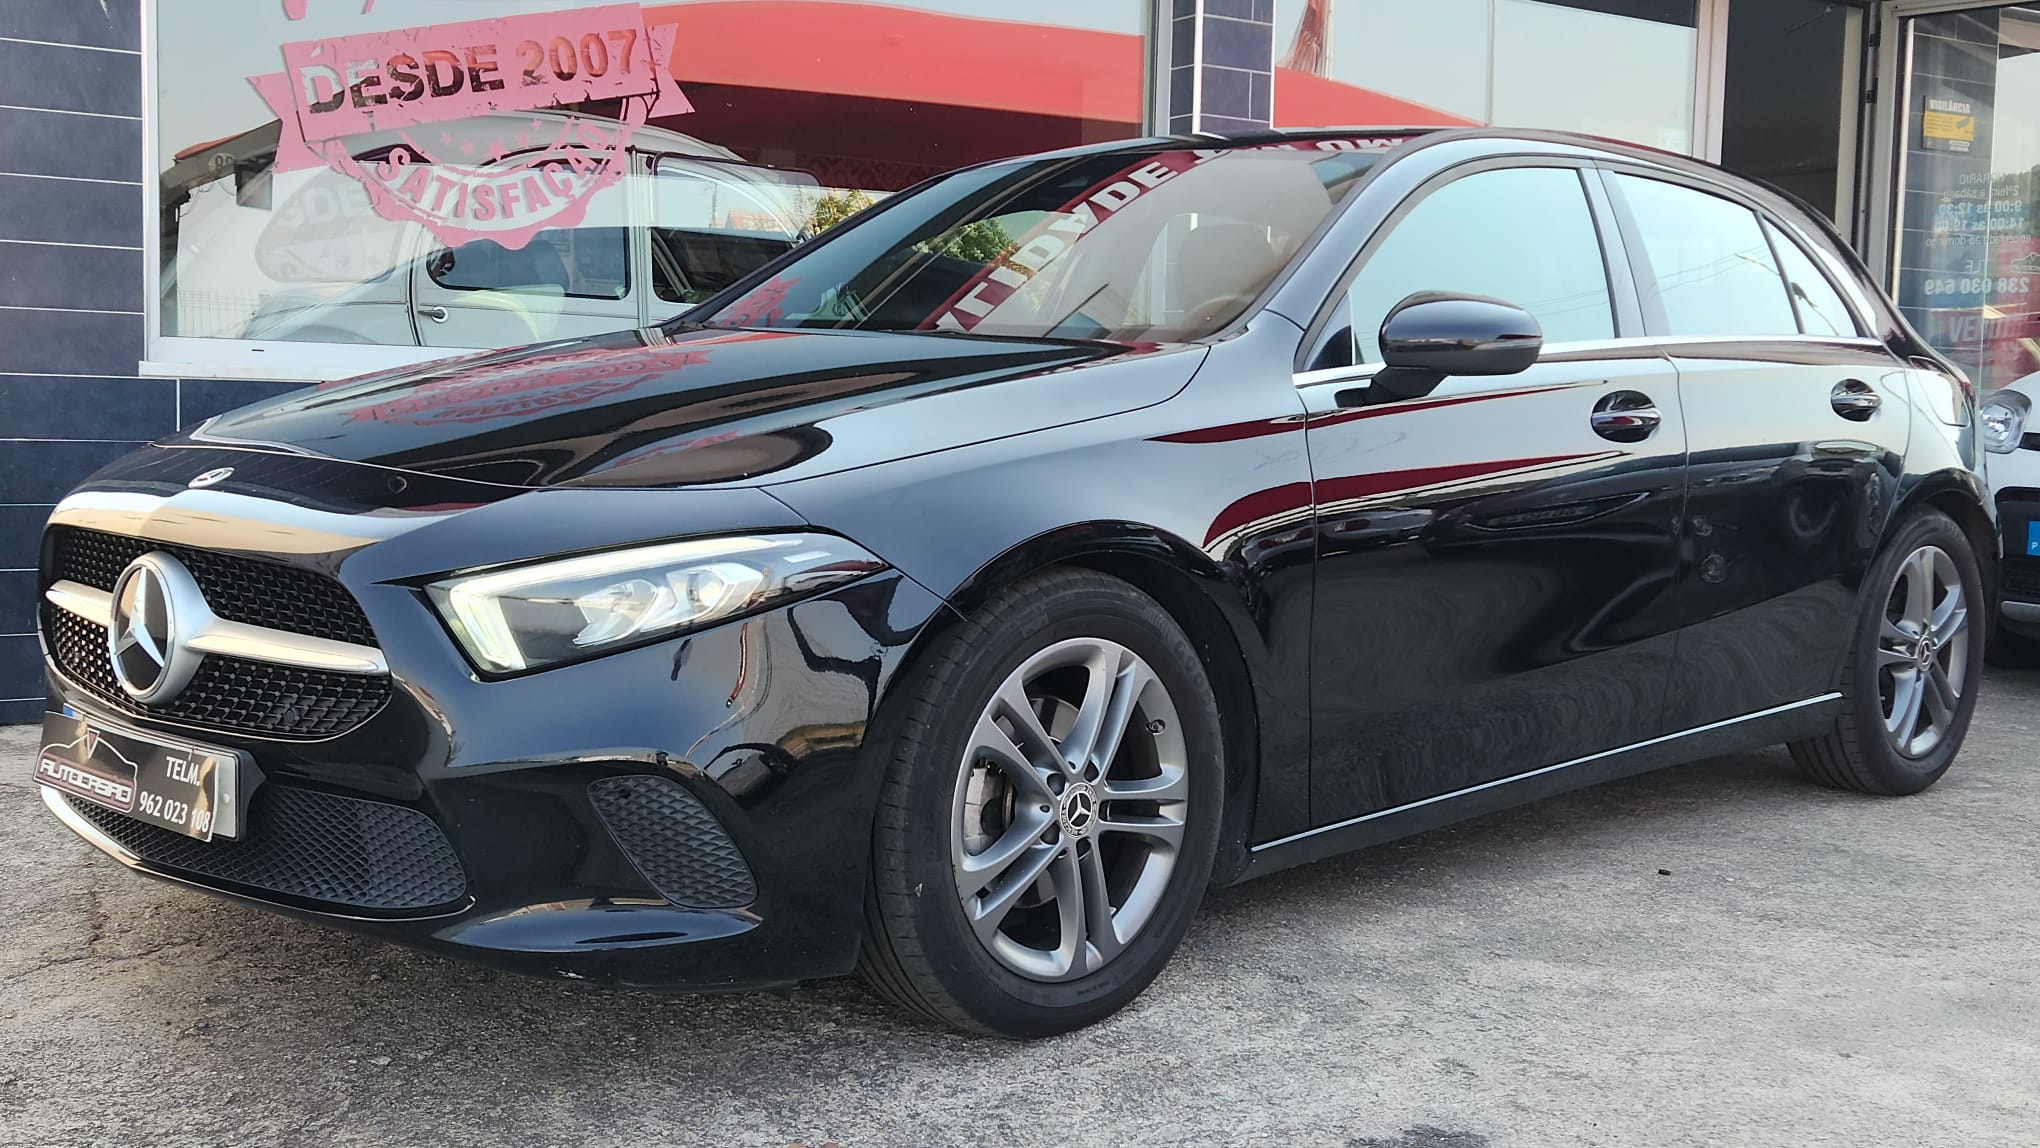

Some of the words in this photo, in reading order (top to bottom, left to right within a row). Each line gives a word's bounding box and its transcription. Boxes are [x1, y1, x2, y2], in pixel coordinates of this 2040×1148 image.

[299, 43, 504, 114] DESDE
[515, 28, 637, 88] 2007
[166, 756, 201, 787] TELM.
[139, 791, 161, 817] 962
[163, 798, 188, 825] 023
[190, 808, 211, 834] 108
